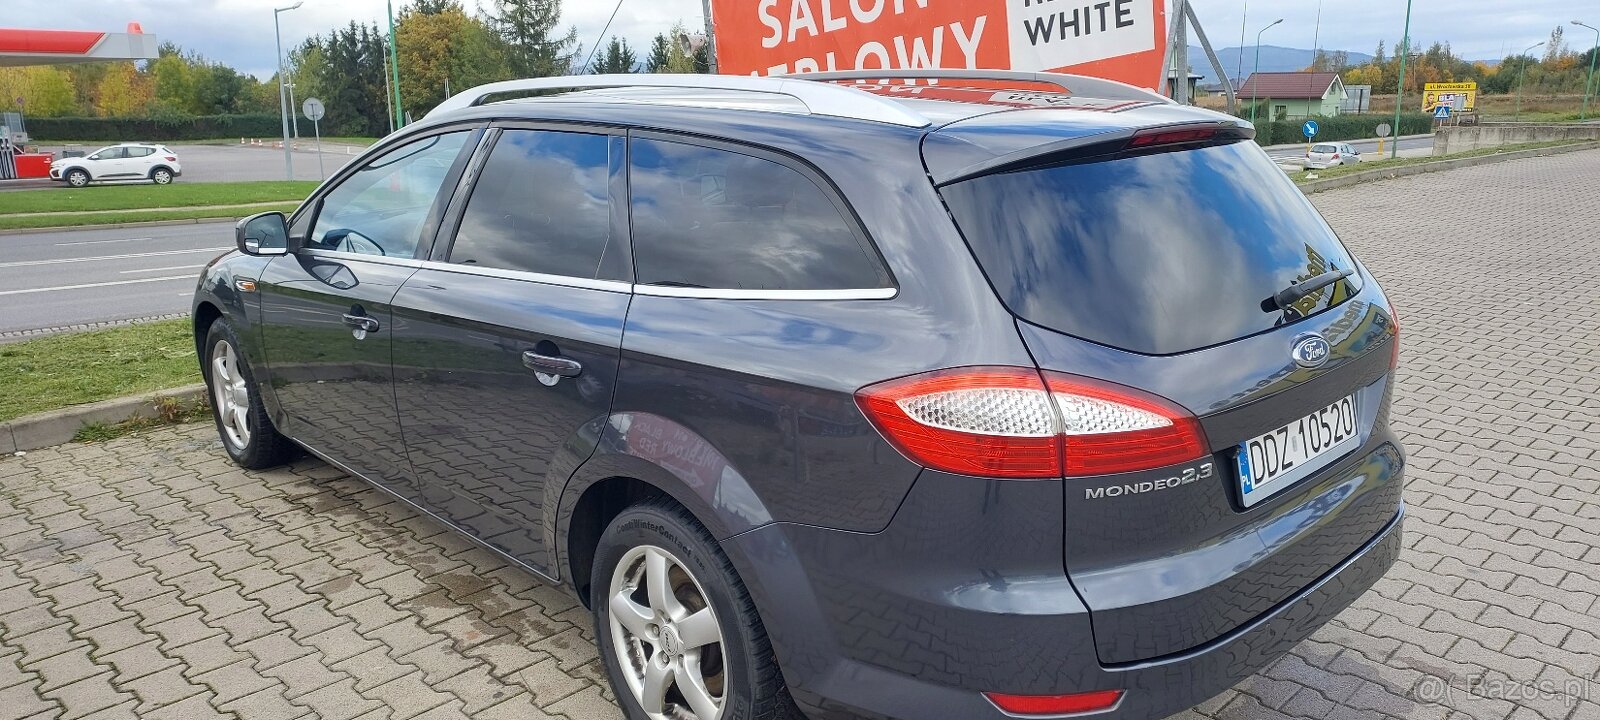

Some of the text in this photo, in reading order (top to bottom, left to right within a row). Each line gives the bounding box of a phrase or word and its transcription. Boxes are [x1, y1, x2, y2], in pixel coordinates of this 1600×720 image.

[758, 0, 928, 48] SALO
[1023, 0, 1134, 46] WHITE
[1304, 341, 1326, 361] Ford
[1249, 398, 1353, 485] DDZ 10520
[1085, 476, 1181, 500] MONDEO
